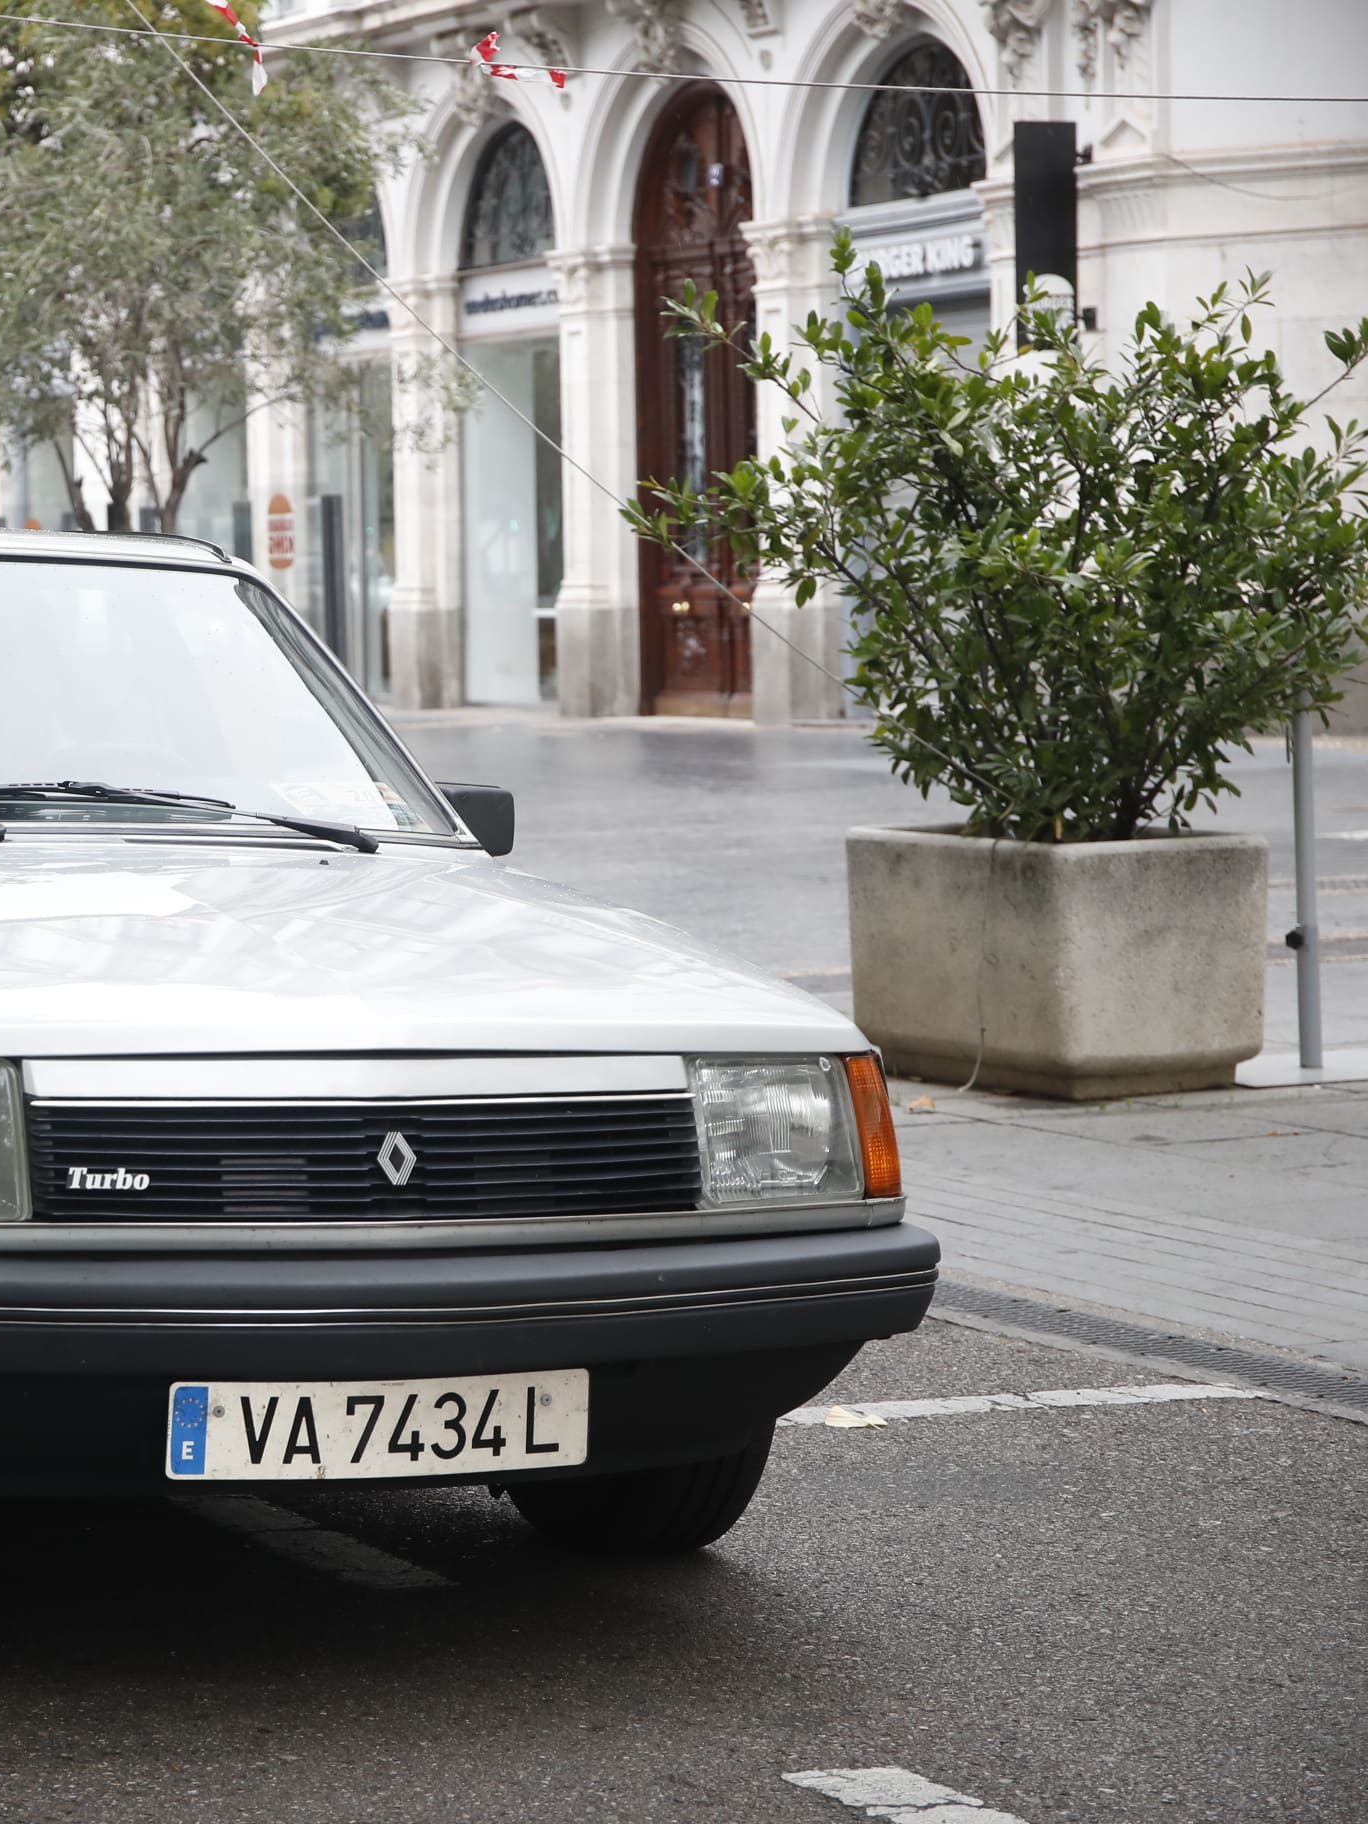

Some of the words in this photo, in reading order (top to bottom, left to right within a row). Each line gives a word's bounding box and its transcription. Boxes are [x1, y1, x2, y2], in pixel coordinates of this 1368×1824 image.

[855, 243, 923, 279] RGER
[926, 235, 973, 271] KING
[68, 1166, 151, 1190] Turbo
[240, 1395, 322, 1465] VA
[346, 1389, 507, 1464] 7434
[525, 1386, 559, 1455] L
[180, 1440, 195, 1461] E
